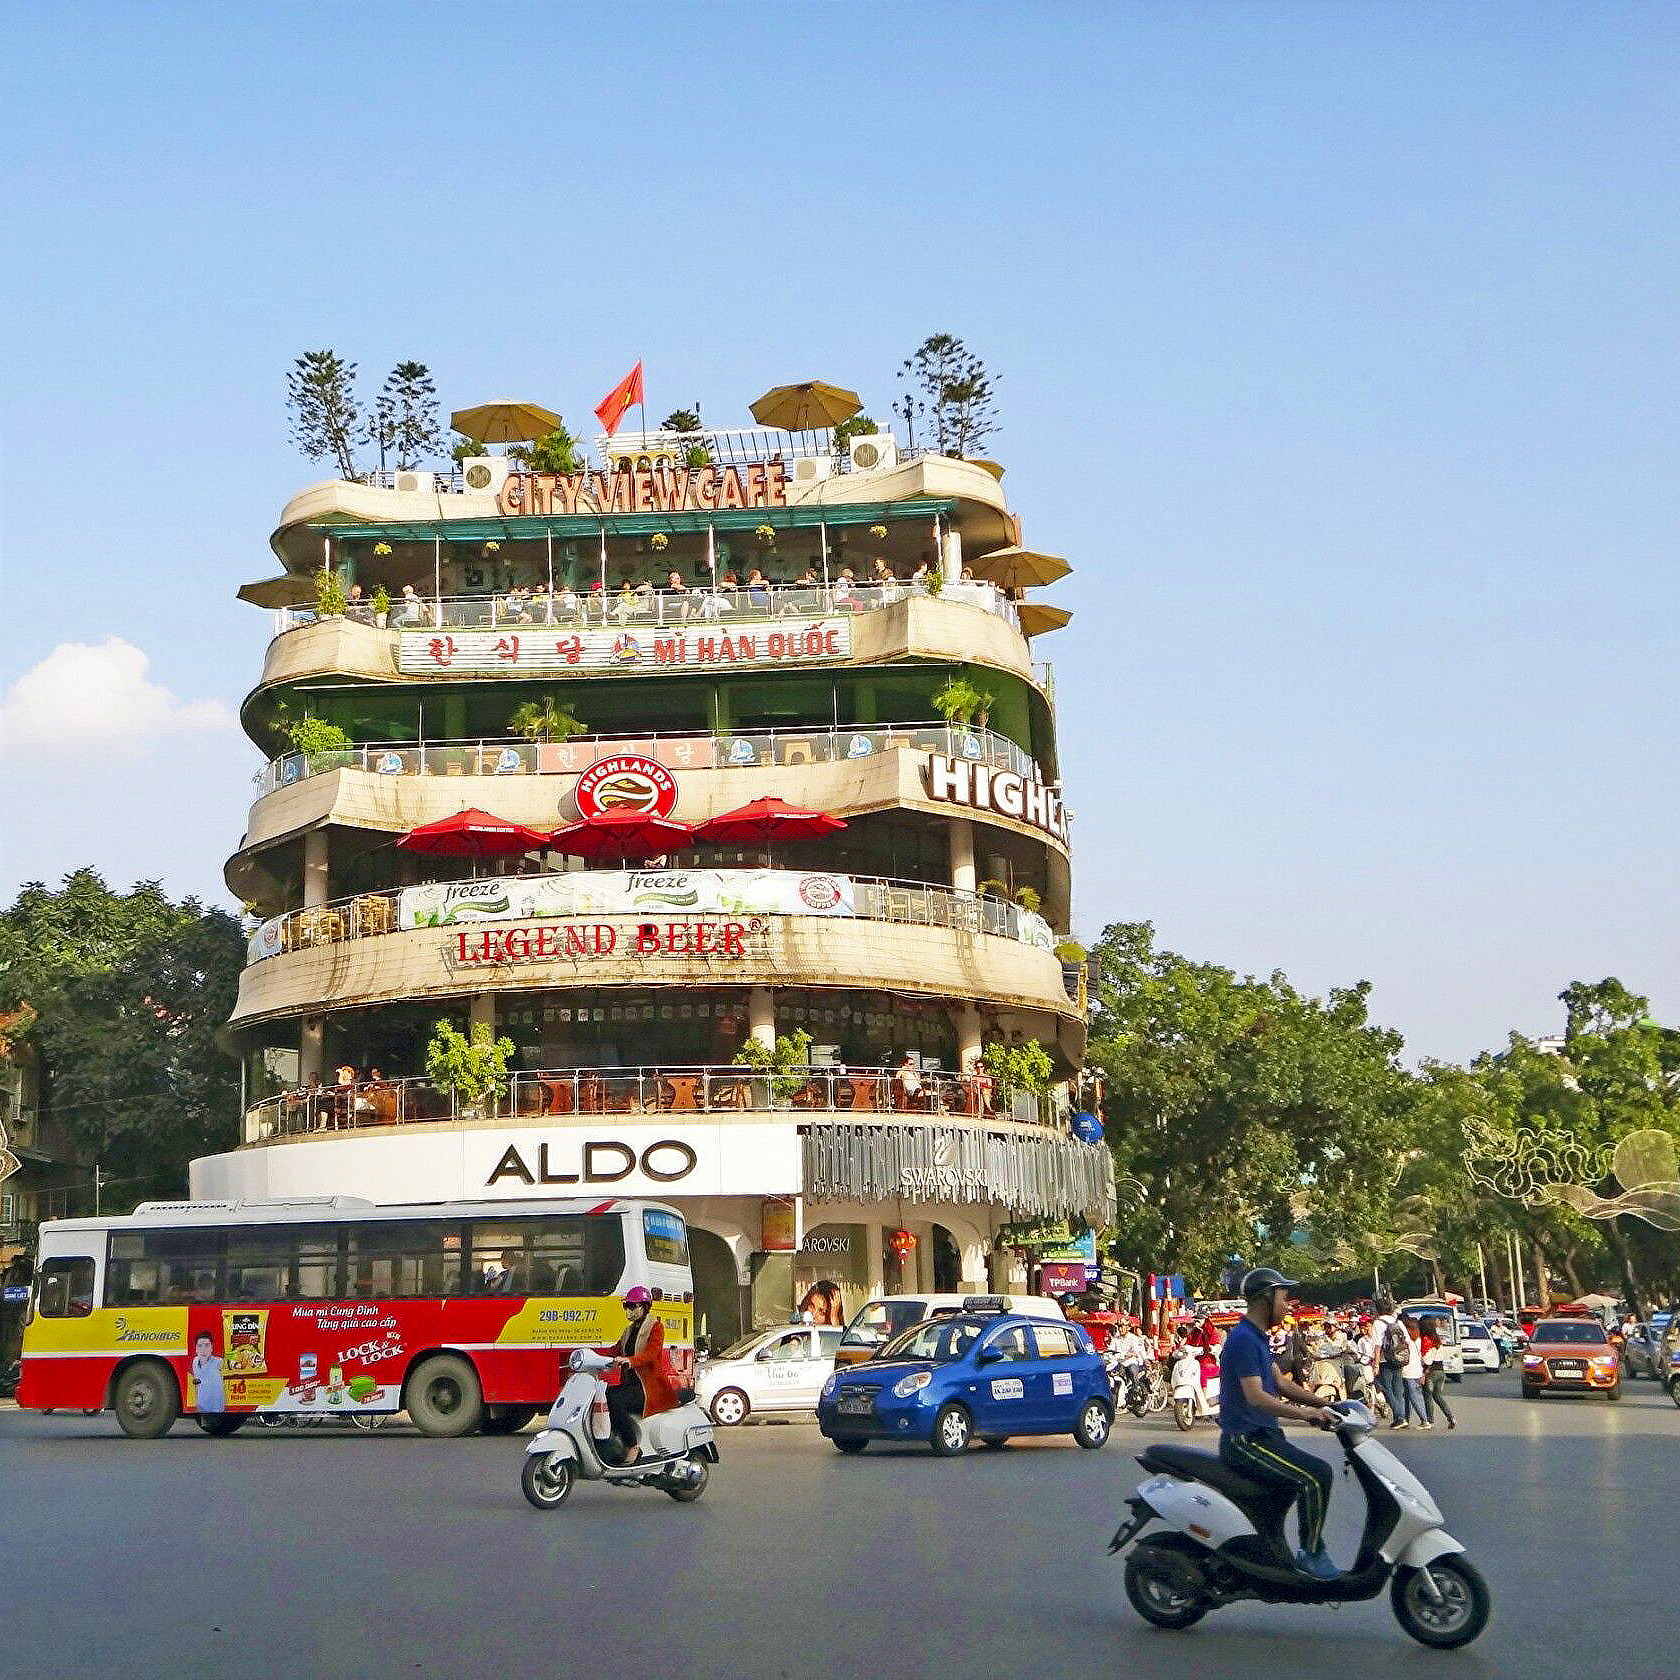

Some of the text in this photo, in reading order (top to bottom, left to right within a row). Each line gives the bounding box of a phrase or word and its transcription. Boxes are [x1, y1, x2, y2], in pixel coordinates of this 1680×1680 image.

[500, 473, 584, 516] CITY
[597, 466, 690, 513] VIEW
[697, 627, 756, 662] HÀN
[768, 620, 840, 658] QUỐC
[581, 759, 673, 793] HIGHLANDS
[929, 753, 1070, 849] HIGHL
[457, 925, 617, 962] LEGEND
[485, 1140, 698, 1187] ALDO
[901, 1167, 987, 1187] SWAROVSKI
[1049, 1277, 1079, 1287] TPBank
[293, 1307, 314, 1317] Mua
[330, 1306, 355, 1318] Cung
[357, 1305, 379, 1316] Đình
[539, 1309, 598, 1322] 29B-092.77
[361, 1319, 378, 1328] cao
[338, 1340, 380, 1363] LOCK
[361, 1344, 405, 1366] LOCK
